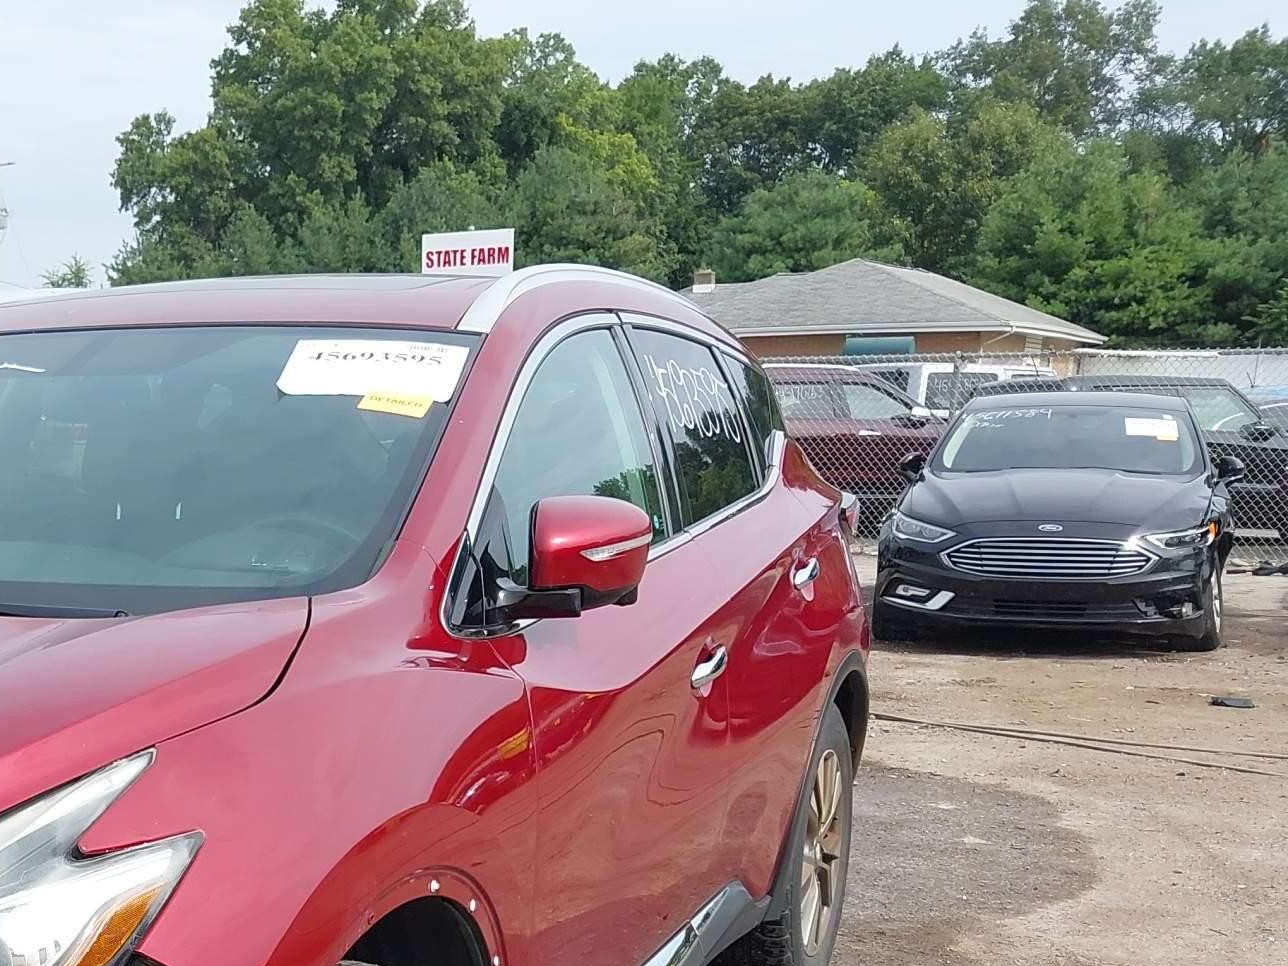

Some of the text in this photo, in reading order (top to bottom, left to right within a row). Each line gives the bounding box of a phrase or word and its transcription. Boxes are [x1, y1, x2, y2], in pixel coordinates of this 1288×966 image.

[425, 246, 509, 269] STATE FARM
[307, 351, 443, 366] 45693595
[369, 395, 423, 408] DETAILED
